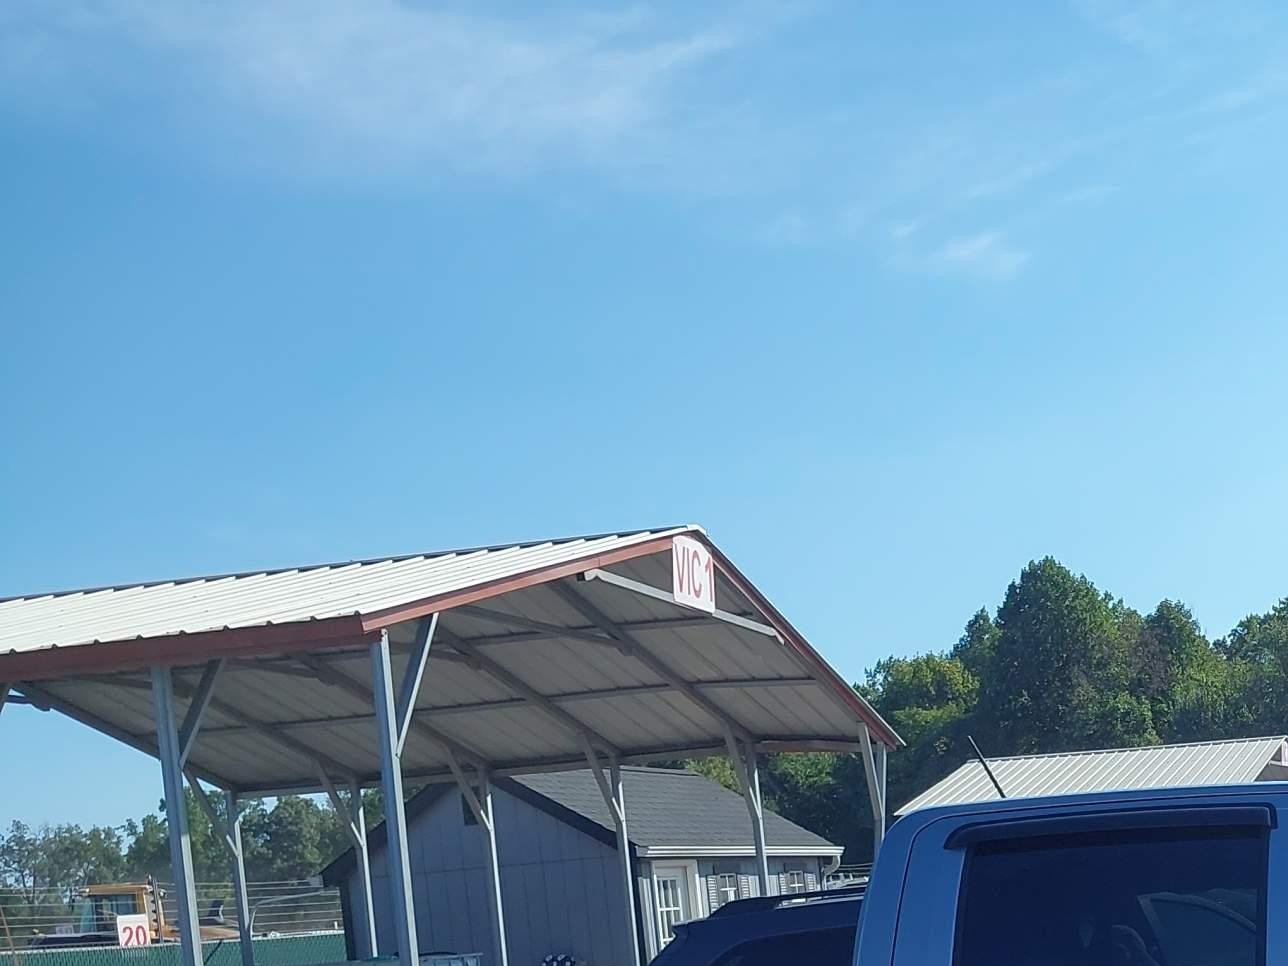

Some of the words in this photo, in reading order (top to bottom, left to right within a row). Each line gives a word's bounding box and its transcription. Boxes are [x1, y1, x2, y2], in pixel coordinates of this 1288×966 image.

[674, 543, 702, 599] VIC
[705, 556, 713, 603] 1
[122, 925, 147, 948] 20
